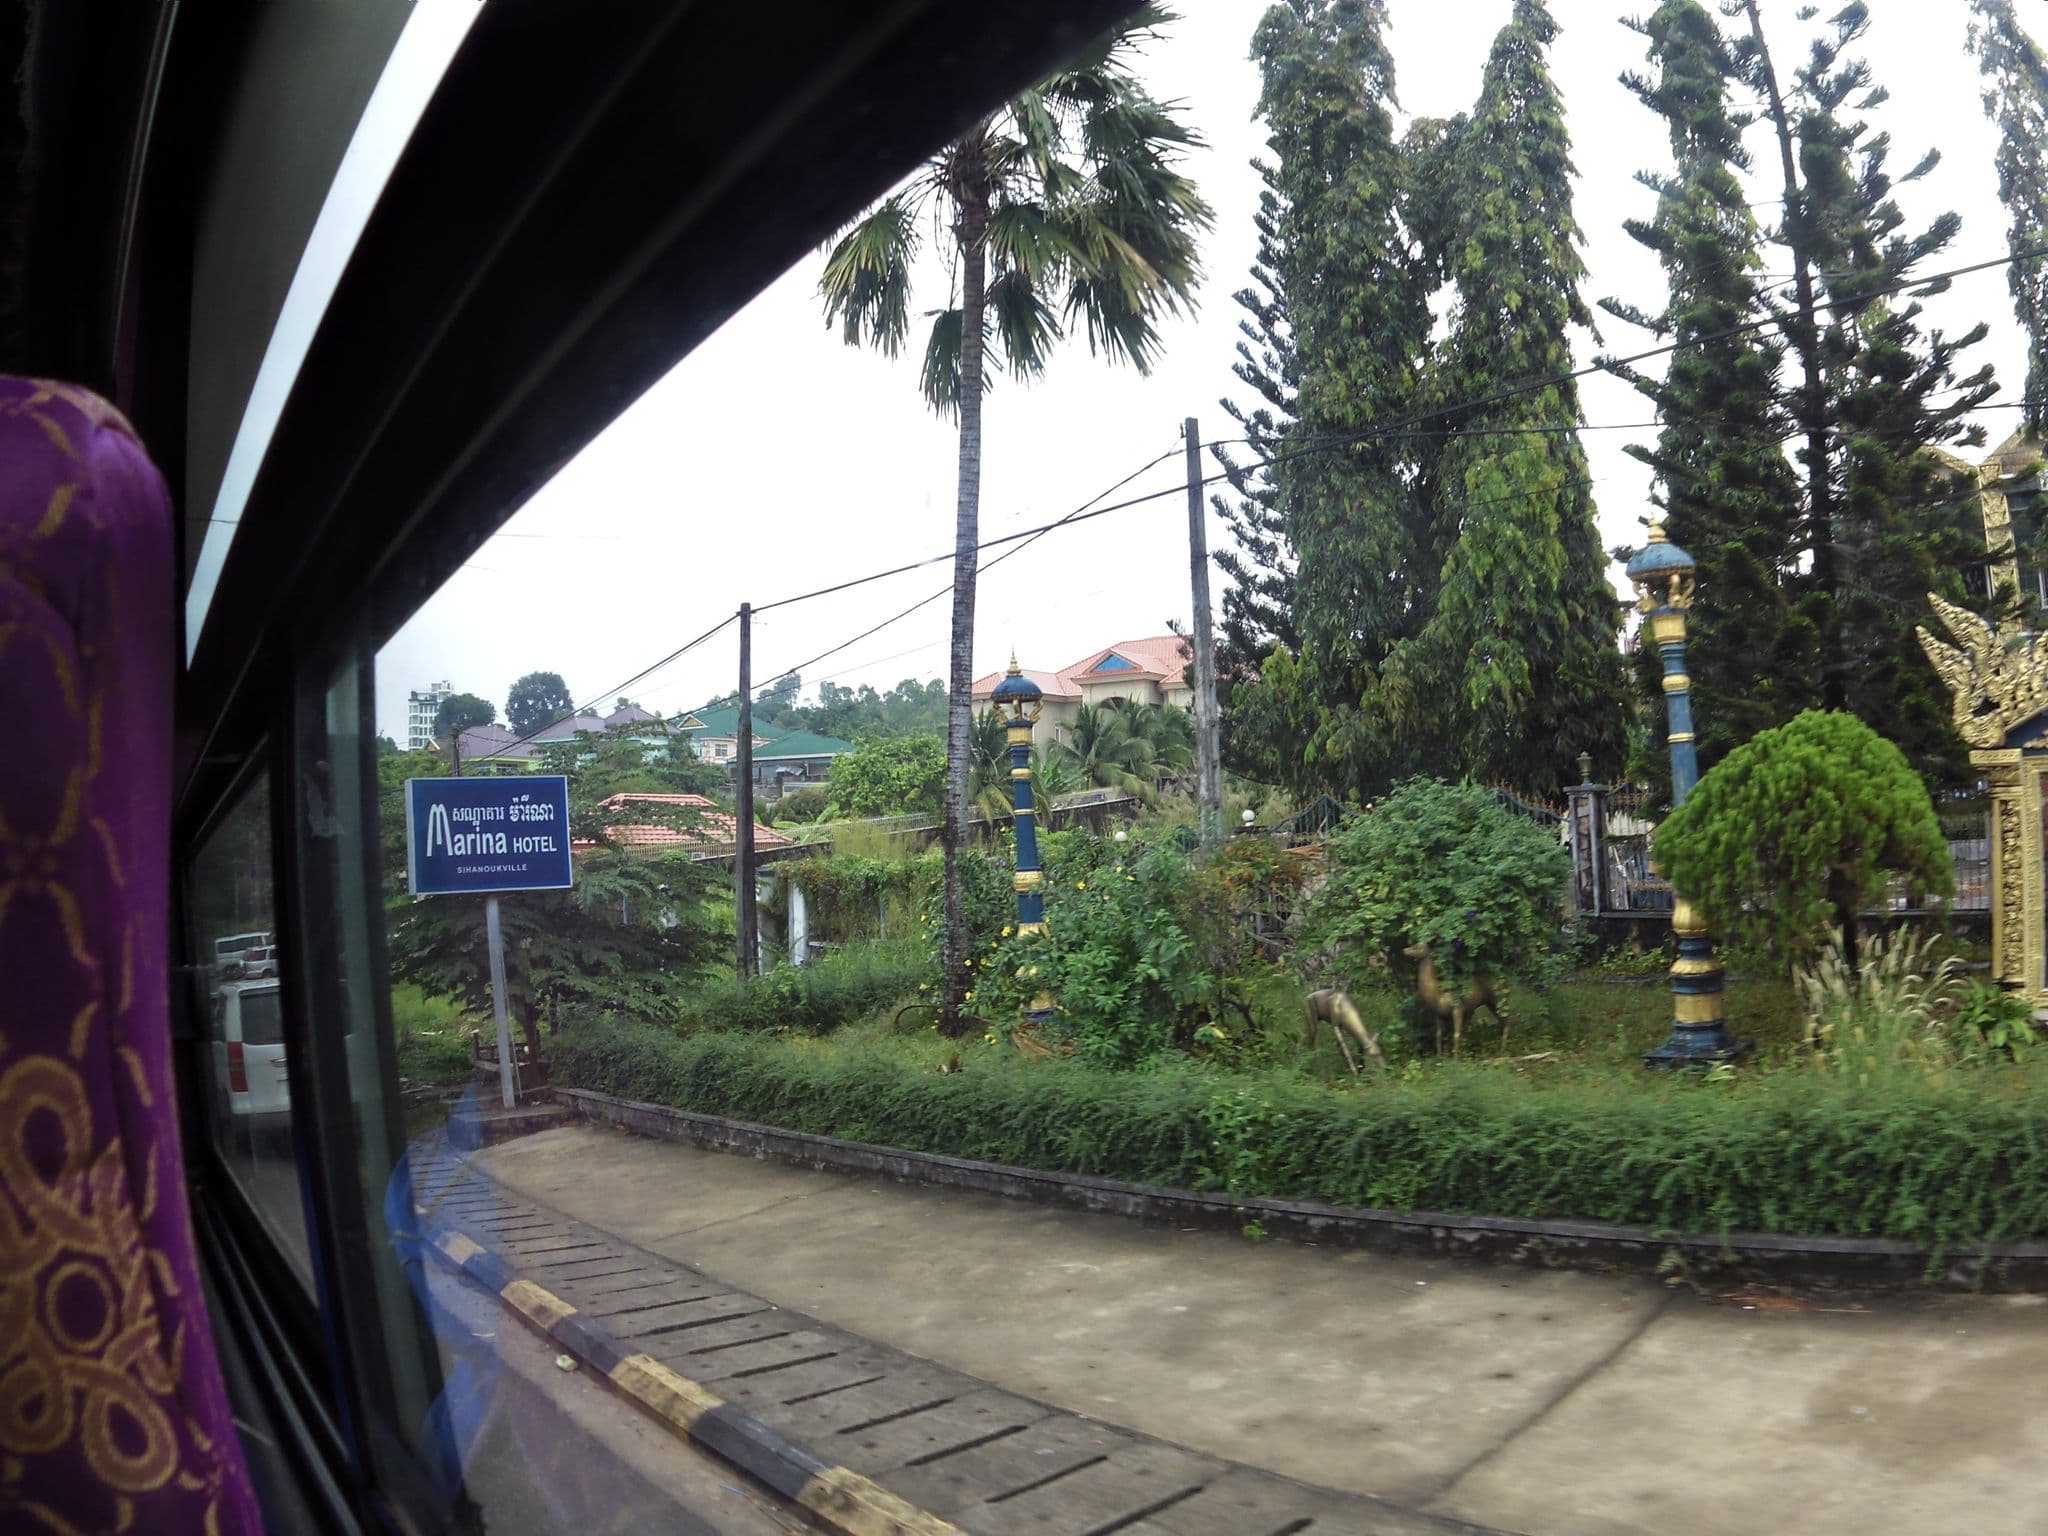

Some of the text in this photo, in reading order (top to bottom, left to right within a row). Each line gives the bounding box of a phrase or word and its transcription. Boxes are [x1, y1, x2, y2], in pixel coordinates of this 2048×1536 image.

[426, 803, 557, 857] Marina HOTEL
[457, 863, 528, 874] SIHANOUKVILLE
